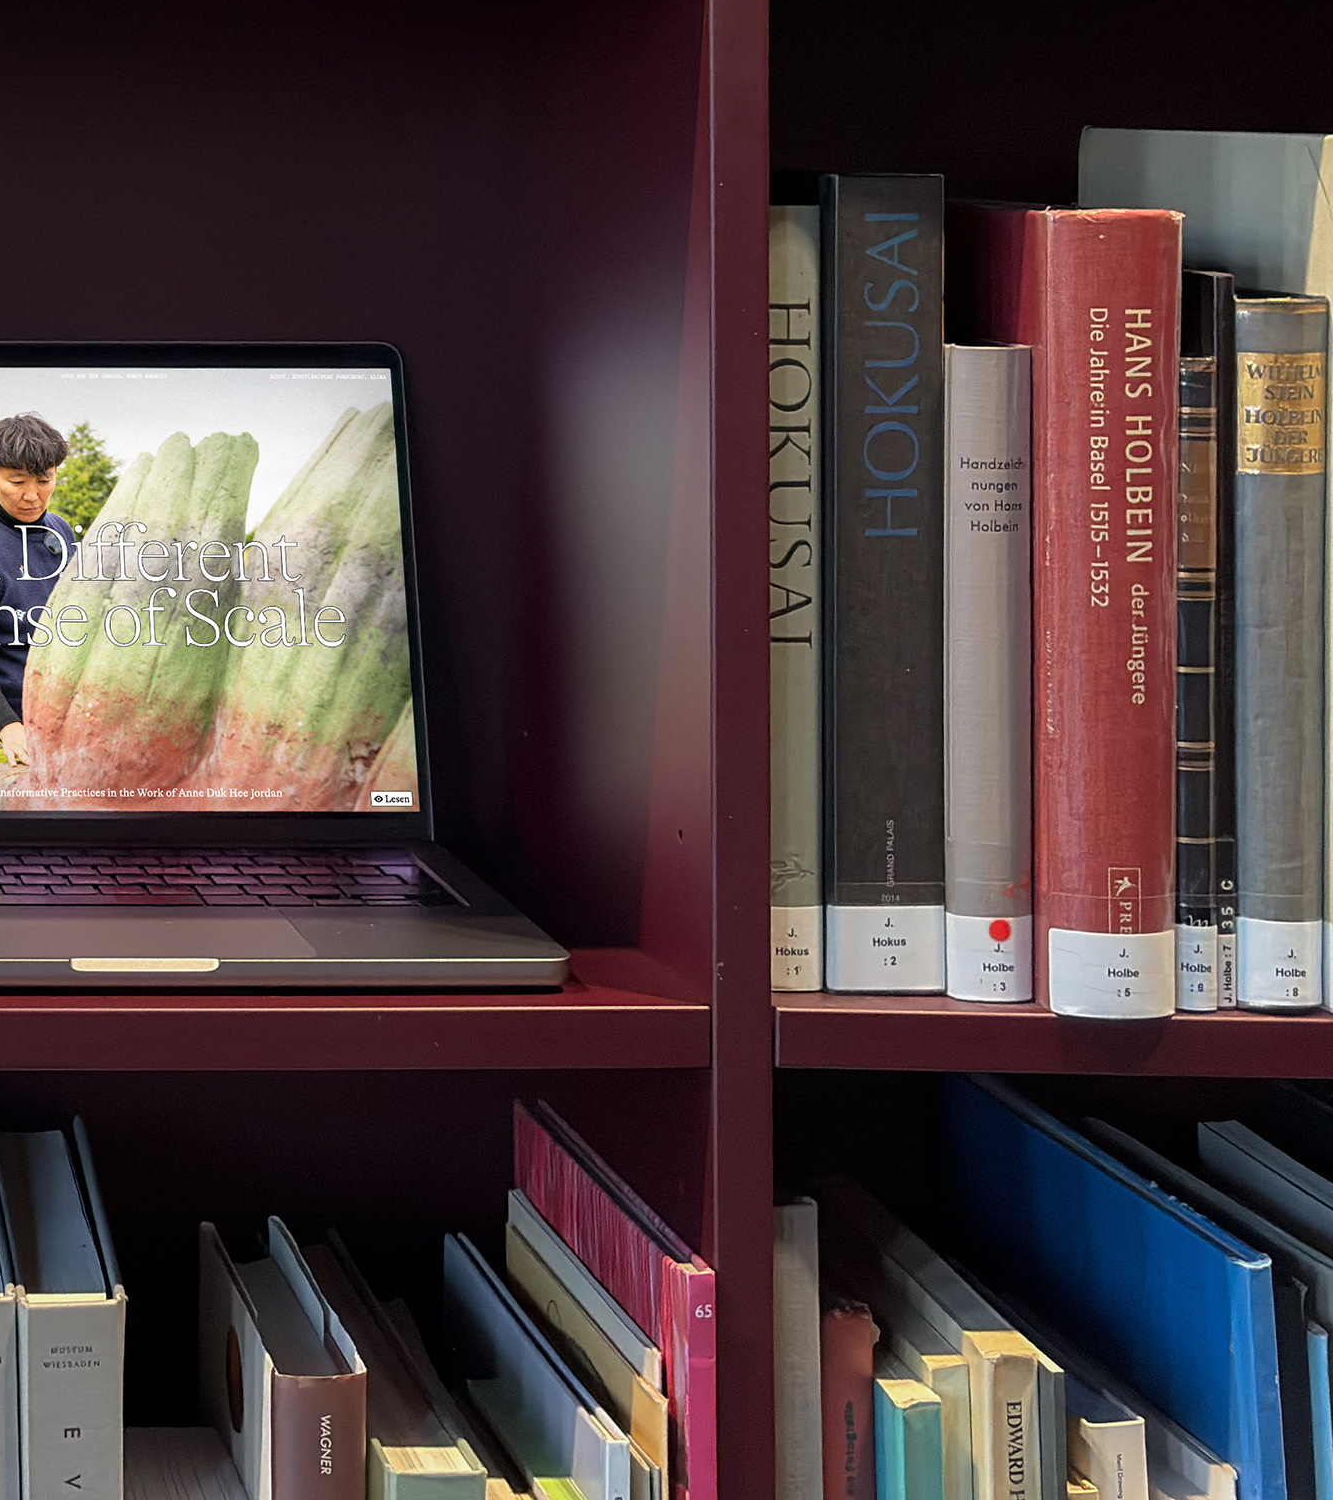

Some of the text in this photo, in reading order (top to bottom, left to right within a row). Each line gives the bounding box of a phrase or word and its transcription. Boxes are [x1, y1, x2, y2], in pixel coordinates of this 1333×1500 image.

[1089, 307, 1108, 342] Die
[864, 212, 920, 539] HOKUSAI
[1089, 347, 1110, 403] Jahre
[1092, 409, 1108, 429] in
[971, 481, 1017, 493] nungen
[1090, 435, 1109, 491] Basel
[971, 520, 1019, 532] Holbein
[1125, 308, 1154, 705] HANS HOLBEIN der Jüngere
[15, 522, 302, 582] Different
[105, 587, 176, 647] of
[185, 587, 346, 648] Scale
[60, 788, 105, 798] Practices
[108, 788, 116, 797] in
[118, 788, 134, 797] the
[137, 788, 164, 798] Work
[166, 788, 178, 797] of
[179, 788, 204, 798] Anne
[207, 788, 227, 798] Duk
[229, 788, 247, 798] Hee
[250, 788, 283, 798] Jordan
[384, 794, 410, 803] Lesen
[695, 1304, 713, 1319] 65
[320, 1415, 332, 1475] WAGNER
[1006, 1401, 1025, 1485] EDWARD
